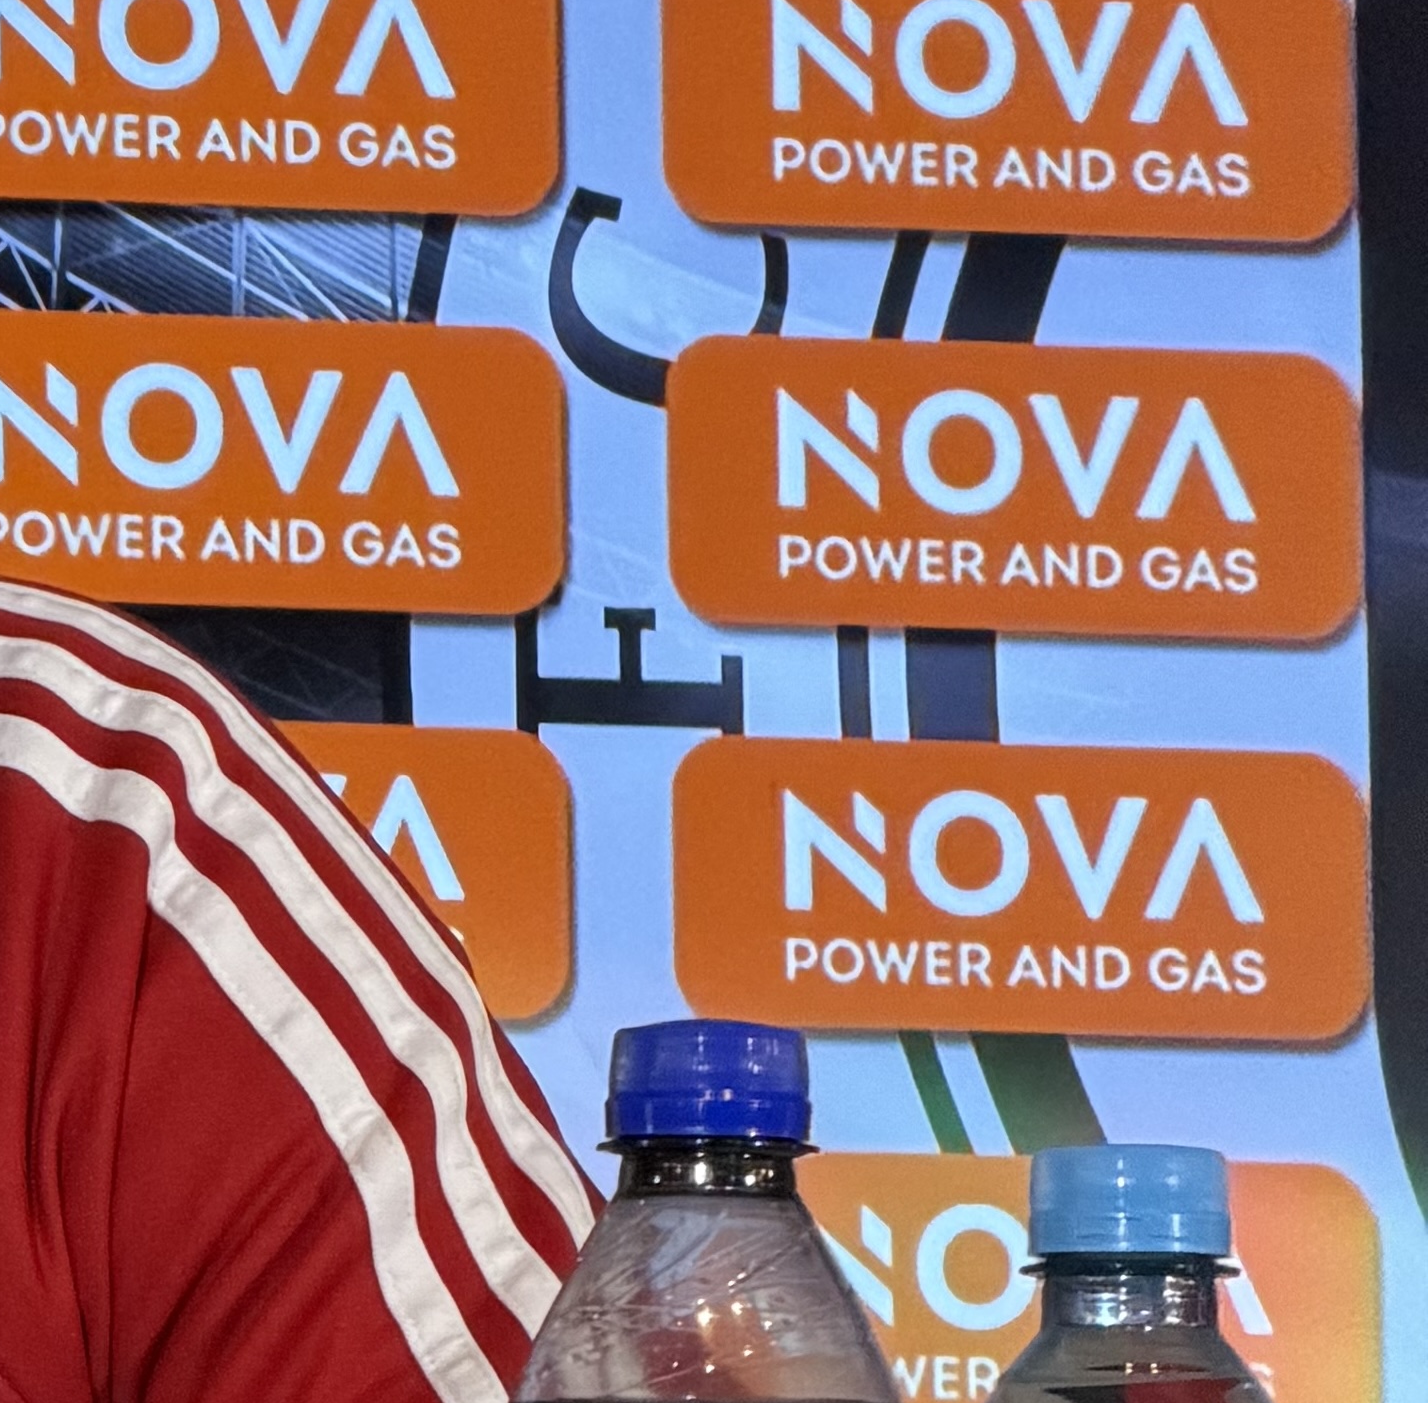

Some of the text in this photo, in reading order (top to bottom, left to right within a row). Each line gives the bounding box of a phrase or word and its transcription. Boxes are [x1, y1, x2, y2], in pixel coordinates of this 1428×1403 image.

[196, 118, 321, 165] AND
[337, 121, 457, 170] GAS
[771, 136, 1251, 198] POWER AND GAS
[775, 387, 1257, 524] NOVA
[200, 518, 326, 565] AND
[341, 520, 462, 569] GAS
[778, 534, 1258, 595] POWER AND GAS
[781, 788, 1265, 925] NOVA
[784, 936, 1267, 995] POWER AND GAS
[892, 1353, 1001, 1401] WER
